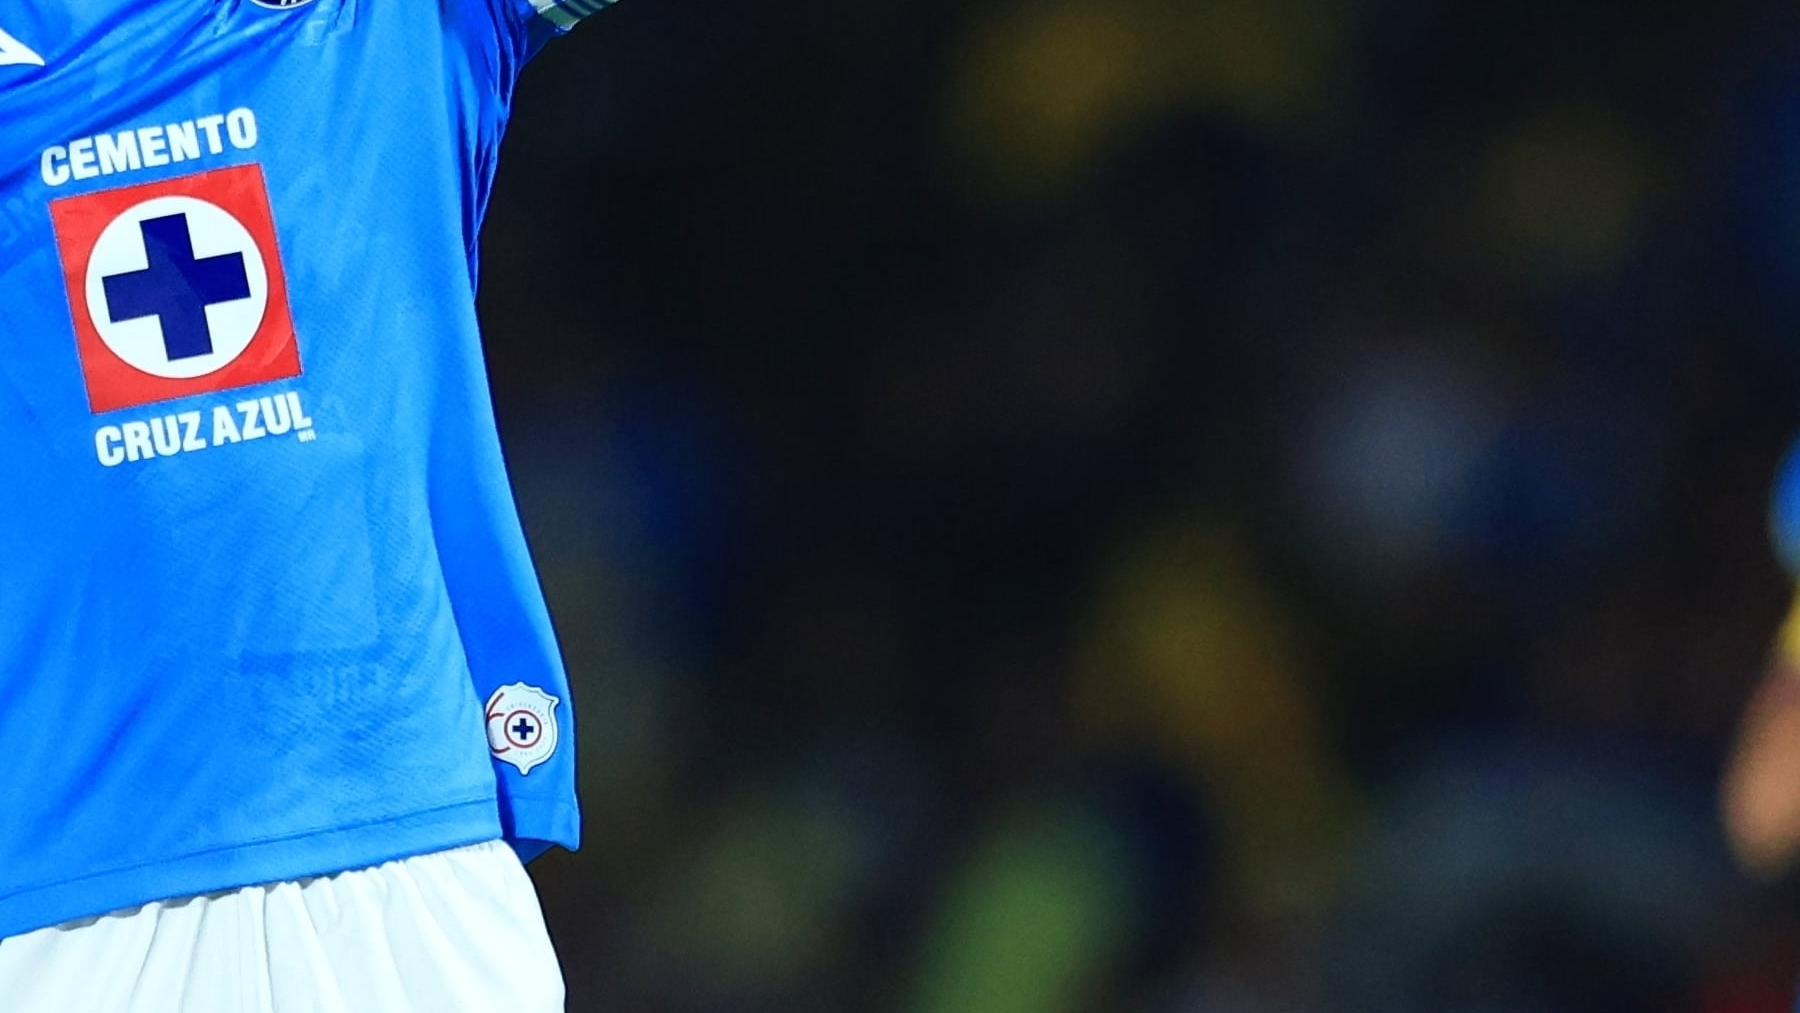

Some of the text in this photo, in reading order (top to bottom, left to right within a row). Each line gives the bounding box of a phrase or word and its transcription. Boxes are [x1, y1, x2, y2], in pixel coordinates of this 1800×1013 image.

[41, 107, 258, 186] CEMENTO
[95, 391, 312, 467] CRUZ AZUL
